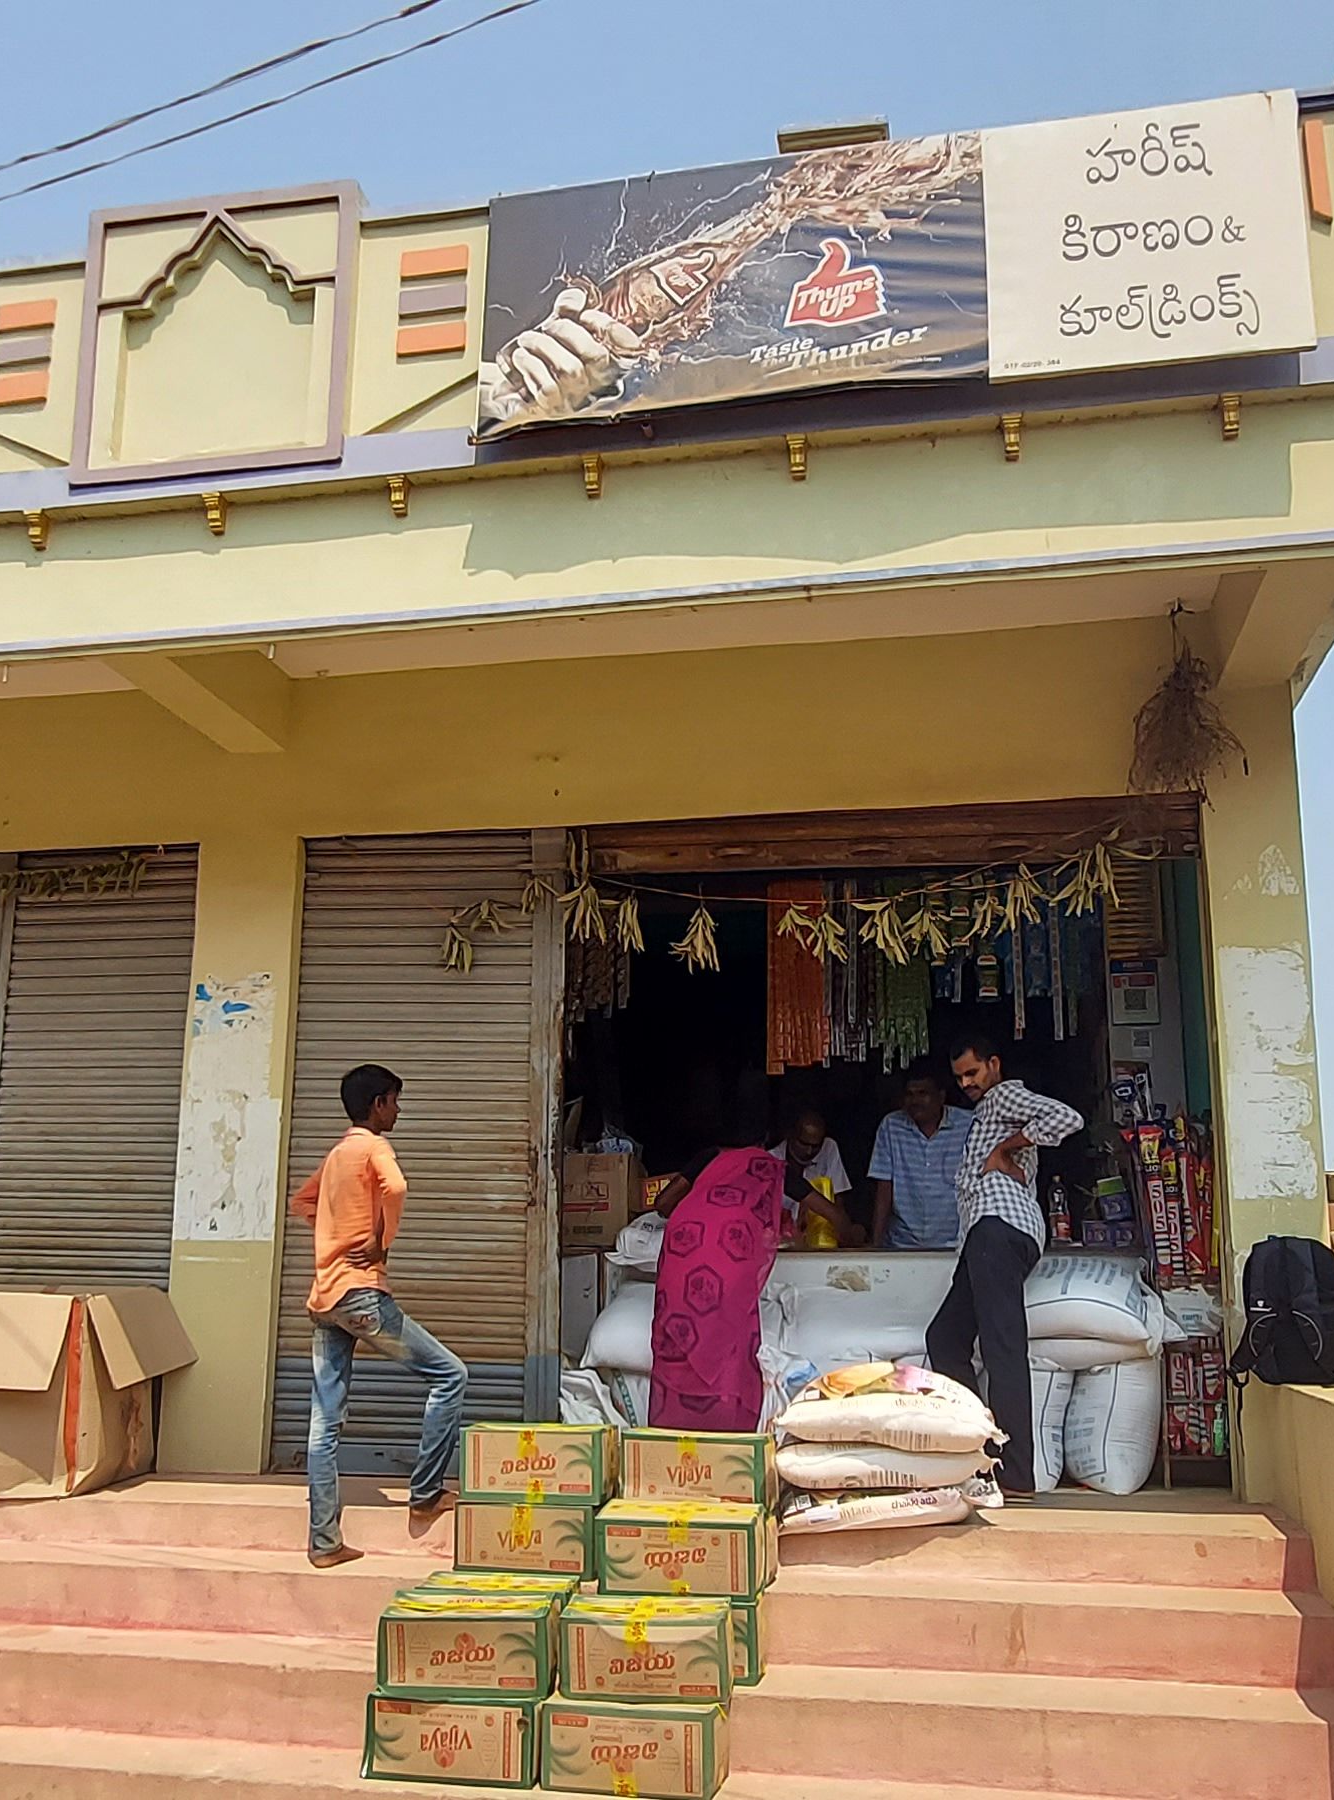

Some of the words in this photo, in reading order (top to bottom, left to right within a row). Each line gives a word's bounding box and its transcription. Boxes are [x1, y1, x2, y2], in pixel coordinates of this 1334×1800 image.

[1085, 123, 1213, 184] హరీష్
[1062, 214, 1214, 261] కిరాణం
[1221, 215, 1247, 243] &
[797, 276, 876, 311] Thums
[749, 337, 815, 364] Taste
[786, 326, 928, 370] Thunder
[666, 1464, 712, 1487] Vijaya
[429, 1643, 496, 1666] విజయ
[609, 1651, 676, 1675] విజయ
[420, 1725, 473, 1752] Vijaya
